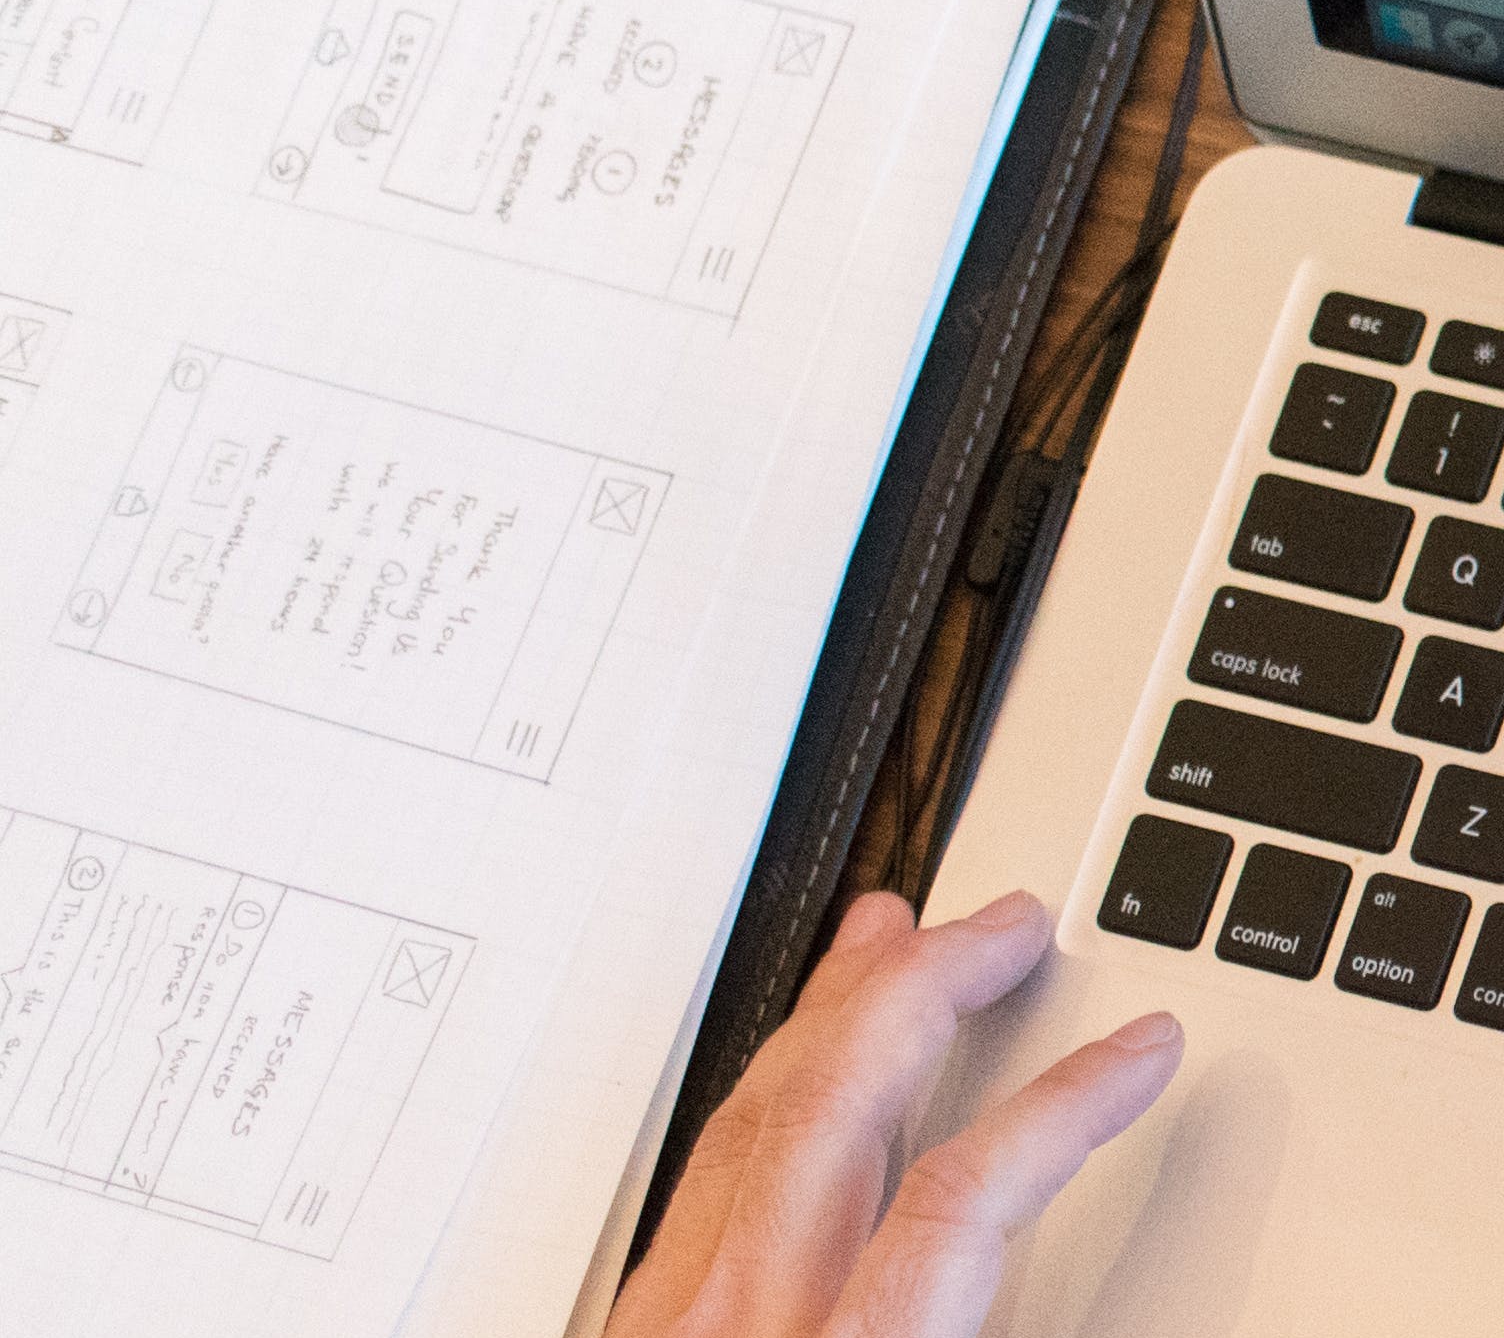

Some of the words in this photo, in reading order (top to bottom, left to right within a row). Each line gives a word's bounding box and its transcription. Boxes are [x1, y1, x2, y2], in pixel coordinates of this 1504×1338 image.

[555, 5, 593, 67] HAVE
[370, 32, 418, 109] SEND
[653, 75, 721, 207] MESSAGES
[1347, 313, 1382, 335] esc
[207, 448, 241, 491] Yes
[254, 433, 290, 480] Have
[376, 461, 400, 490] We
[1434, 446, 1450, 476] 1
[326, 462, 356, 513] with
[355, 501, 380, 538] will
[397, 487, 446, 540] Your
[450, 493, 480, 528] For
[216, 495, 257, 575] another
[303, 536, 324, 564] 24
[465, 505, 521, 582] Thank
[1250, 534, 1284, 558] tab
[167, 551, 197, 588] No
[384, 532, 462, 629] Sending
[1450, 553, 1479, 586] Q
[270, 574, 310, 632] hours
[309, 554, 356, 636] respond
[340, 558, 412, 675] Question!
[431, 605, 478, 657] You
[390, 632, 418, 656] Us
[1210, 650, 1258, 675] caps
[1261, 658, 1302, 685] lock
[1438, 674, 1464, 708] A
[1169, 763, 1213, 788] shift
[1459, 804, 1489, 839] Z
[1120, 892, 1142, 916] fn
[1372, 891, 1397, 909] alt
[48, 894, 85, 946] This
[1230, 924, 1301, 954] control
[151, 902, 217, 1010] Response
[213, 932, 246, 971] Do
[1350, 954, 1416, 984] option
[17, 987, 46, 1020] the
[158, 1035, 202, 1094] have
[211, 1014, 259, 1100] RECEIVED
[230, 989, 315, 1138] MESSAGES
